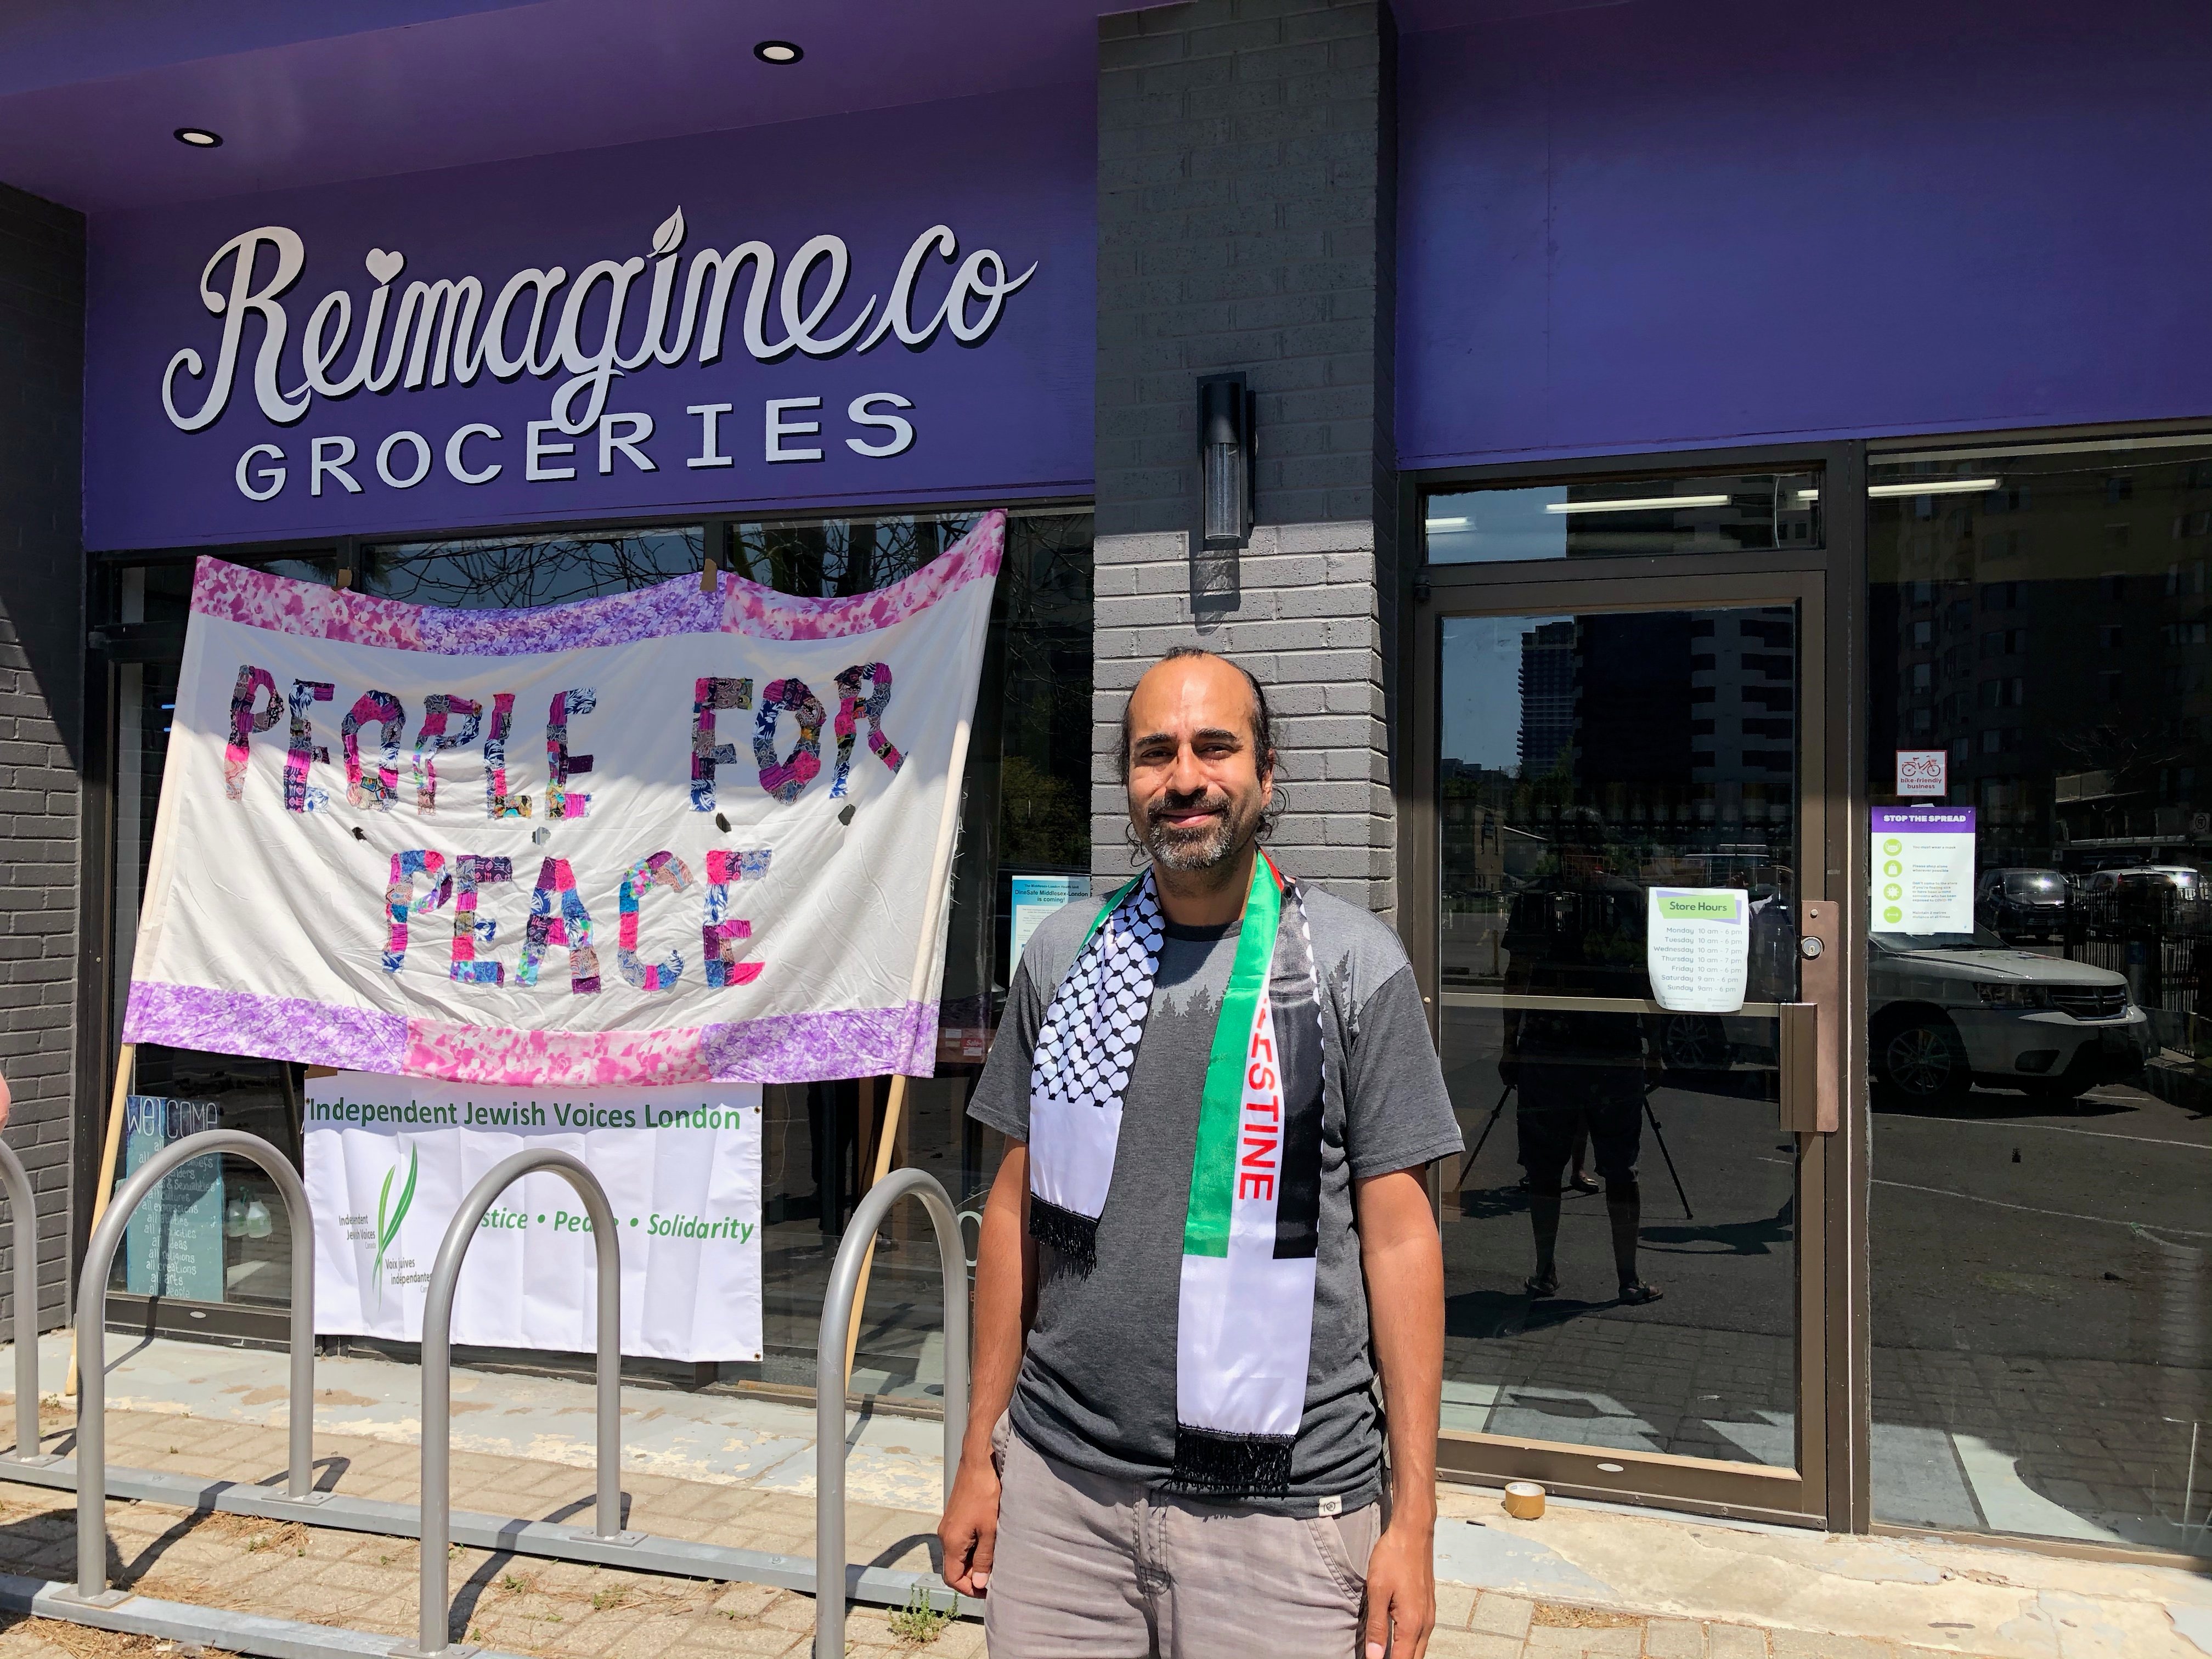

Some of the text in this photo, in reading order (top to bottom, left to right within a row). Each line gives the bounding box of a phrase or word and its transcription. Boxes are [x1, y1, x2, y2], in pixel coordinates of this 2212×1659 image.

[162, 205, 877, 436] Reimagine
[235, 392, 917, 503] GROCERIES
[224, 661, 909, 821] PEOPLE FOR
[1669, 901, 1727, 911] Store Hours
[381, 848, 772, 995] PEACE
[1664, 936, 1694, 945] Tuesday
[1654, 946, 1694, 954] Wednesday
[1661, 955, 1694, 963] Thursday
[1672, 965, 1694, 973] Friday
[1661, 974, 1694, 983] Saturday
[1239, 998, 1278, 1201] ESTINE
[309, 1097, 741, 1131] Independent Jewish Voices London
[154, 1139, 164, 1152] all
[138, 1151, 149, 1164] all
[165, 1167, 195, 1180] enders
[148, 1188, 190, 1203] all cultures
[142, 1200, 151, 1211] all
[147, 1211, 157, 1224] all
[338, 1214, 369, 1226] Independent
[144, 1223, 197, 1239] all enicities
[480, 1207, 528, 1229] stice
[647, 1213, 754, 1244] Solidarity
[347, 1228, 376, 1241] Jewish Voices
[151, 1235, 162, 1248] all
[365, 1242, 376, 1250] Canada
[148, 1248, 195, 1264] all religions
[146, 1260, 197, 1276] all creations
[385, 1258, 415, 1272] Voix juives
[150, 1272, 183, 1286] all arts
[166, 1286, 190, 1299] people
[420, 1285, 428, 1293] Can
